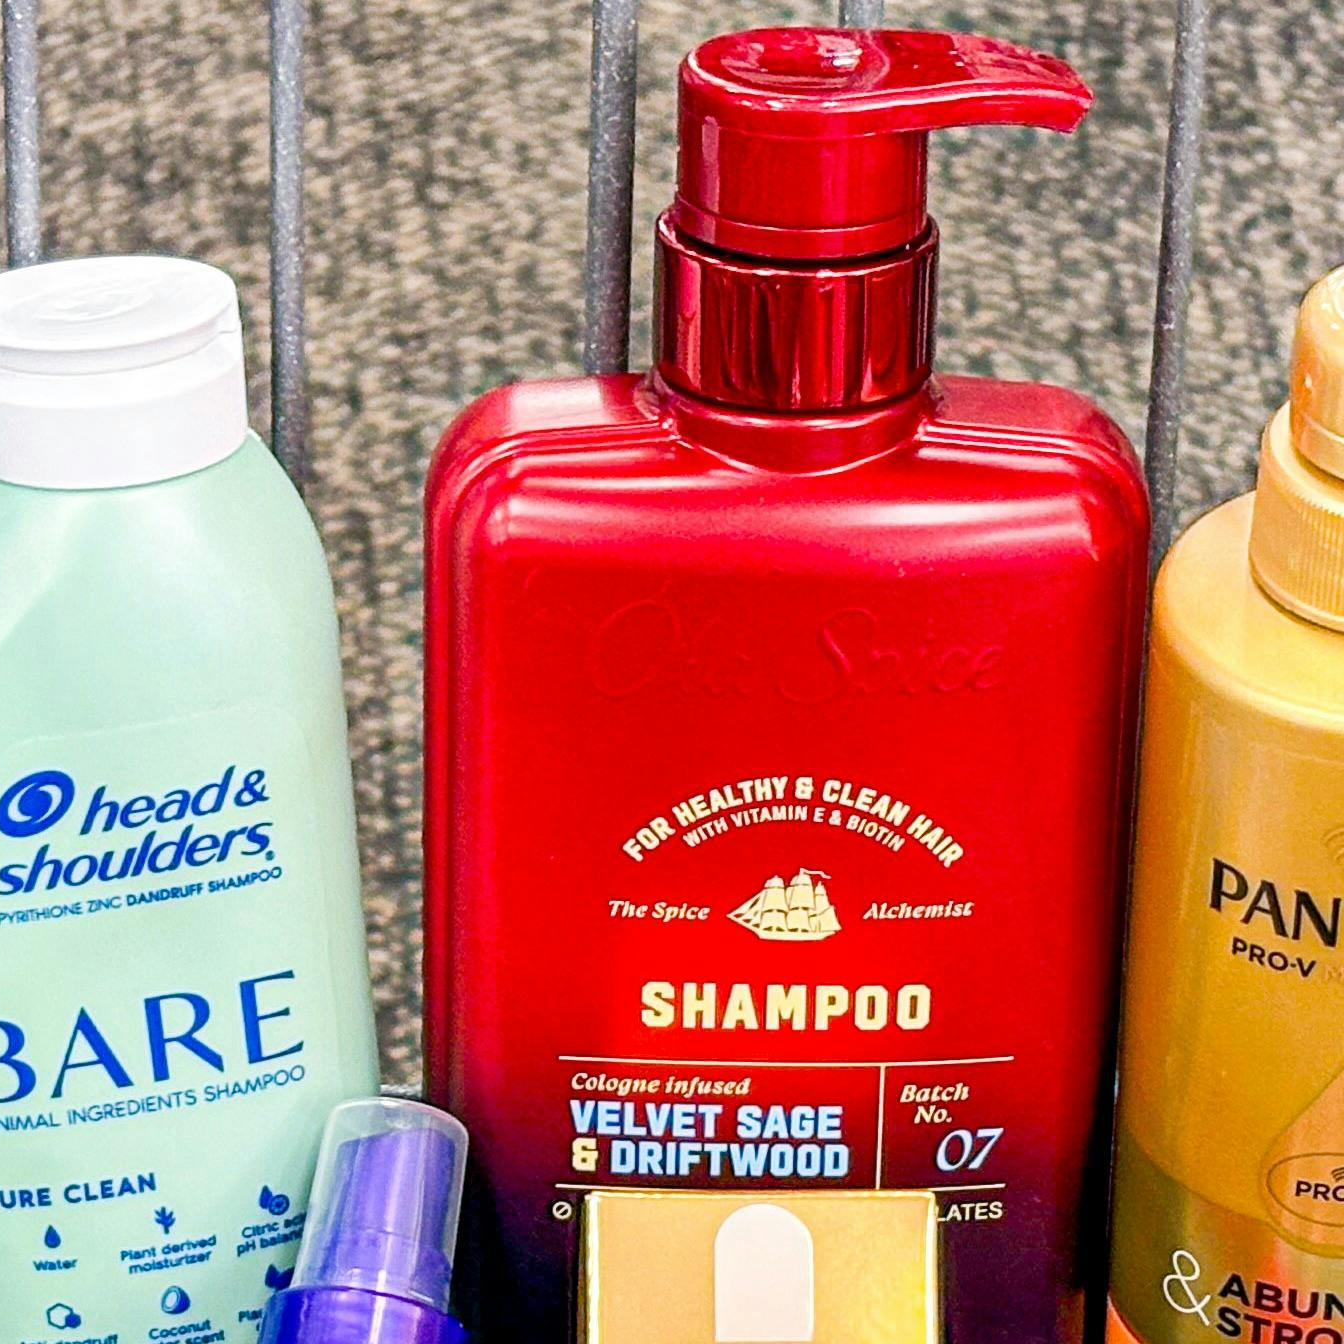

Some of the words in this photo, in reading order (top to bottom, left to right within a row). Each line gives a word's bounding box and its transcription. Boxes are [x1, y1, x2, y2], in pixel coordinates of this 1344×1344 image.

[622, 814, 676, 863] FOR
[672, 776, 789, 826] HEALTHY
[822, 780, 911, 828] CLEAN
[905, 814, 964, 868] HAIR
[683, 819, 729, 848] WITH
[730, 805, 808, 827] VITAMIN
[847, 814, 905, 852] BIOTIN
[87, 895, 122, 913] ZINC
[126, 882, 204, 906] DANDRUFF
[208, 867, 282, 892] SHAMPOO
[608, 900, 648, 919] The
[652, 901, 710, 922] Spice
[862, 901, 975, 921] Alchemist
[1231, 937, 1317, 978] PRO-V
[640, 980, 932, 1031] SHAMPOO
[68, 1091, 197, 1125] INGREDIENTS
[204, 1065, 305, 1101] SHAMPOO
[571, 1072, 660, 1097] Cologne
[664, 1076, 751, 1096] infused
[900, 1083, 970, 1103] Batch
[569, 1100, 724, 1137] VELVET
[736, 1105, 843, 1140] SAGE
[571, 1138, 599, 1172] &
[610, 1141, 850, 1178] DRIFTWOOD
[935, 1127, 1004, 1172] 07
[64, 1172, 157, 1204] CLEAN
[33, 1258, 77, 1271] Water
[128, 1252, 212, 1274] moisturizer
[1163, 1251, 1211, 1326] &
[148, 1320, 211, 1340] Coconut
